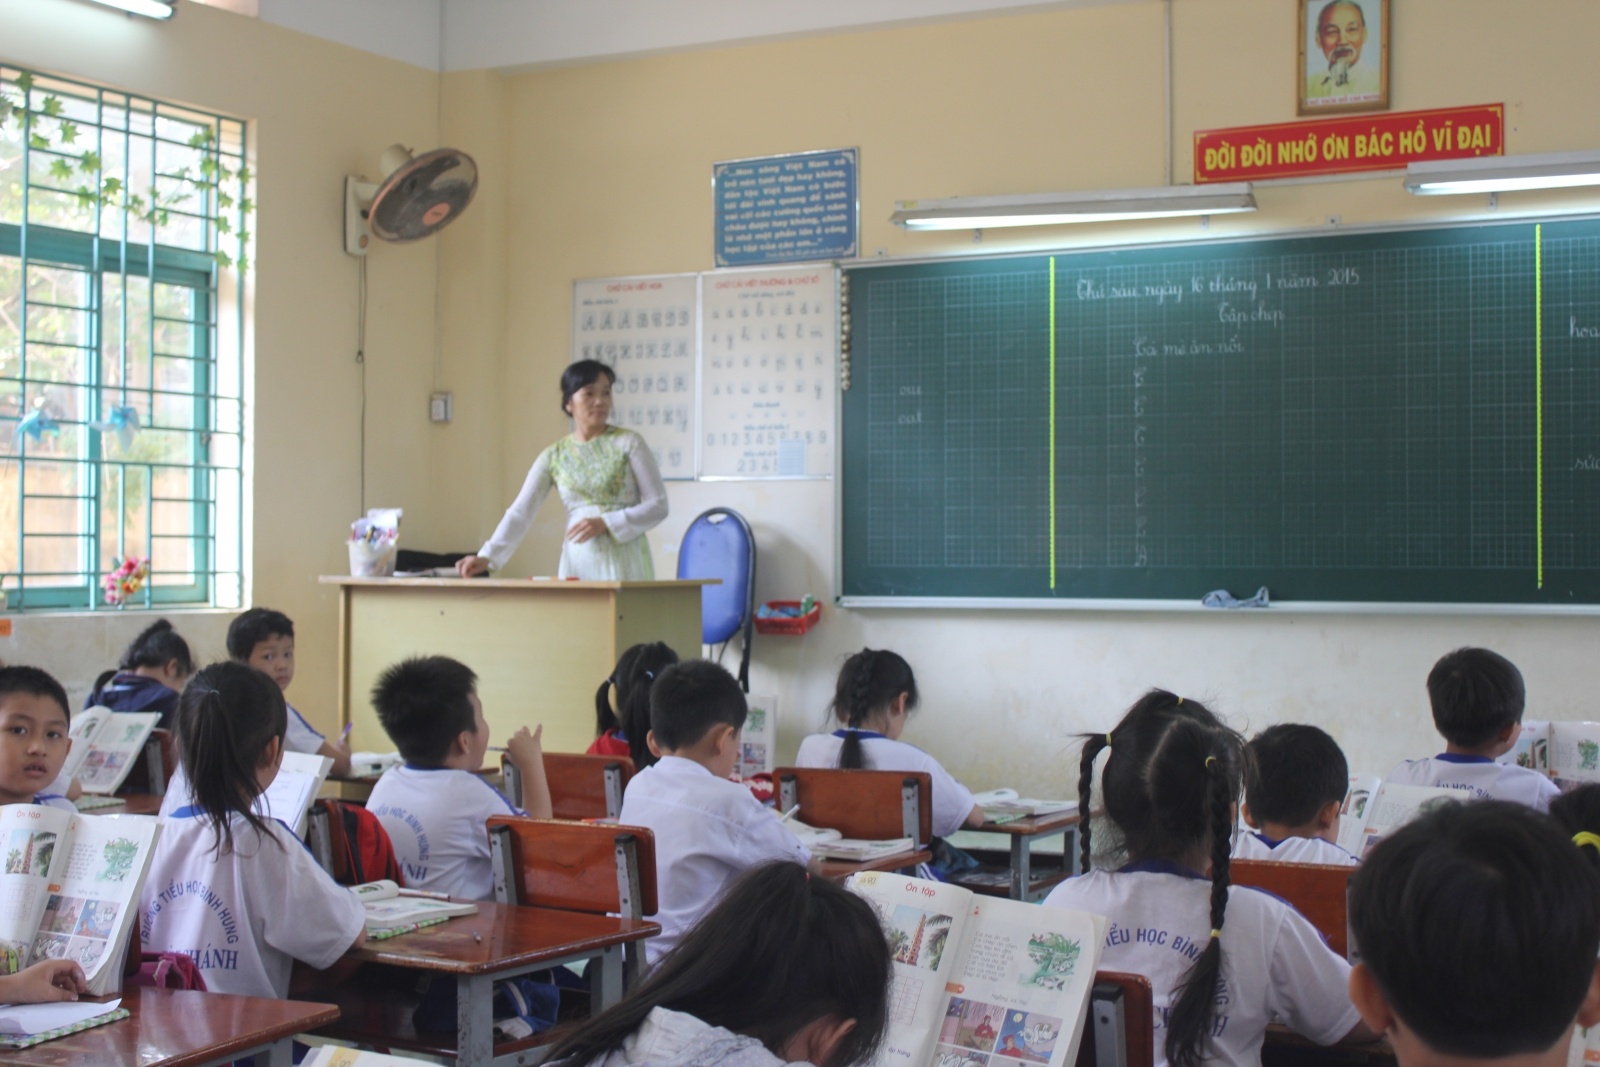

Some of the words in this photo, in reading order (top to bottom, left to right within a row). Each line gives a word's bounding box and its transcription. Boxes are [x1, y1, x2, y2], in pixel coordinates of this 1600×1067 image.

[1204, 140, 1235, 170] ĐỜI
[1240, 137, 1272, 168] ĐỜI
[1278, 132, 1317, 165] NHỚ
[1322, 132, 1349, 161] ƠN
[1355, 126, 1394, 158] BÁC
[1399, 119, 1427, 154] HỒ
[1432, 120, 1452, 152] VĨ
[1457, 123, 1491, 156] ĐẠI
[808, 160, 829, 168] Nam
[797, 173, 813, 181] hay
[784, 185, 805, 193] Nam
[1145, 280, 1183, 305] ngày
[1191, 276, 1204, 293] 16
[1209, 273, 1257, 300] tháng
[1277, 273, 1319, 289] năm
[1328, 267, 1360, 286] 2015
[706, 433, 715, 446] 0
[731, 432, 739, 446] 2
[743, 432, 751, 446] 3
[755, 432, 764, 445] 4
[767, 431, 776, 445] 5
[819, 430, 827, 444] 9
[737, 459, 745, 472] 2
[748, 459, 756, 472] 3
[159, 879, 184, 904] TIỂU
[200, 886, 223, 911] BÌNH
[905, 881, 918, 893] Ôn
[922, 886, 936, 898] tập
[1103, 923, 1130, 950] IỂU
[1136, 928, 1168, 946] HỌC
